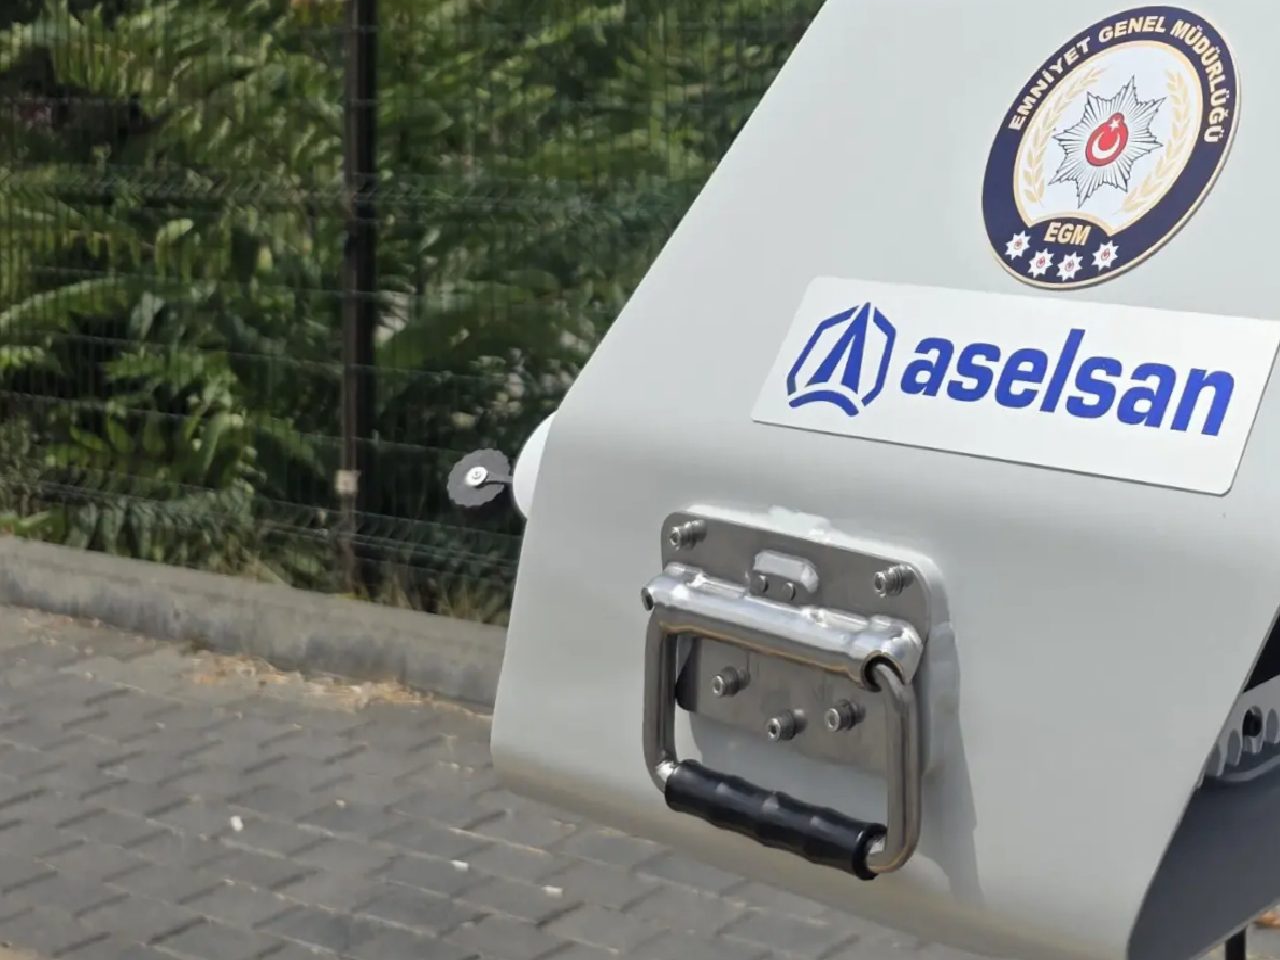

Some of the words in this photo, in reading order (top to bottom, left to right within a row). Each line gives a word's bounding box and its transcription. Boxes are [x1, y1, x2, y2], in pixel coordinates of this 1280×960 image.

[1008, 37, 1092, 131] EMNİYET
[1098, 16, 1167, 43] GENEL
[1170, 19, 1229, 143] MÜDÜRLÜĞÜ
[1044, 222, 1092, 246] EGM
[900, 328, 1235, 437] aselsan
